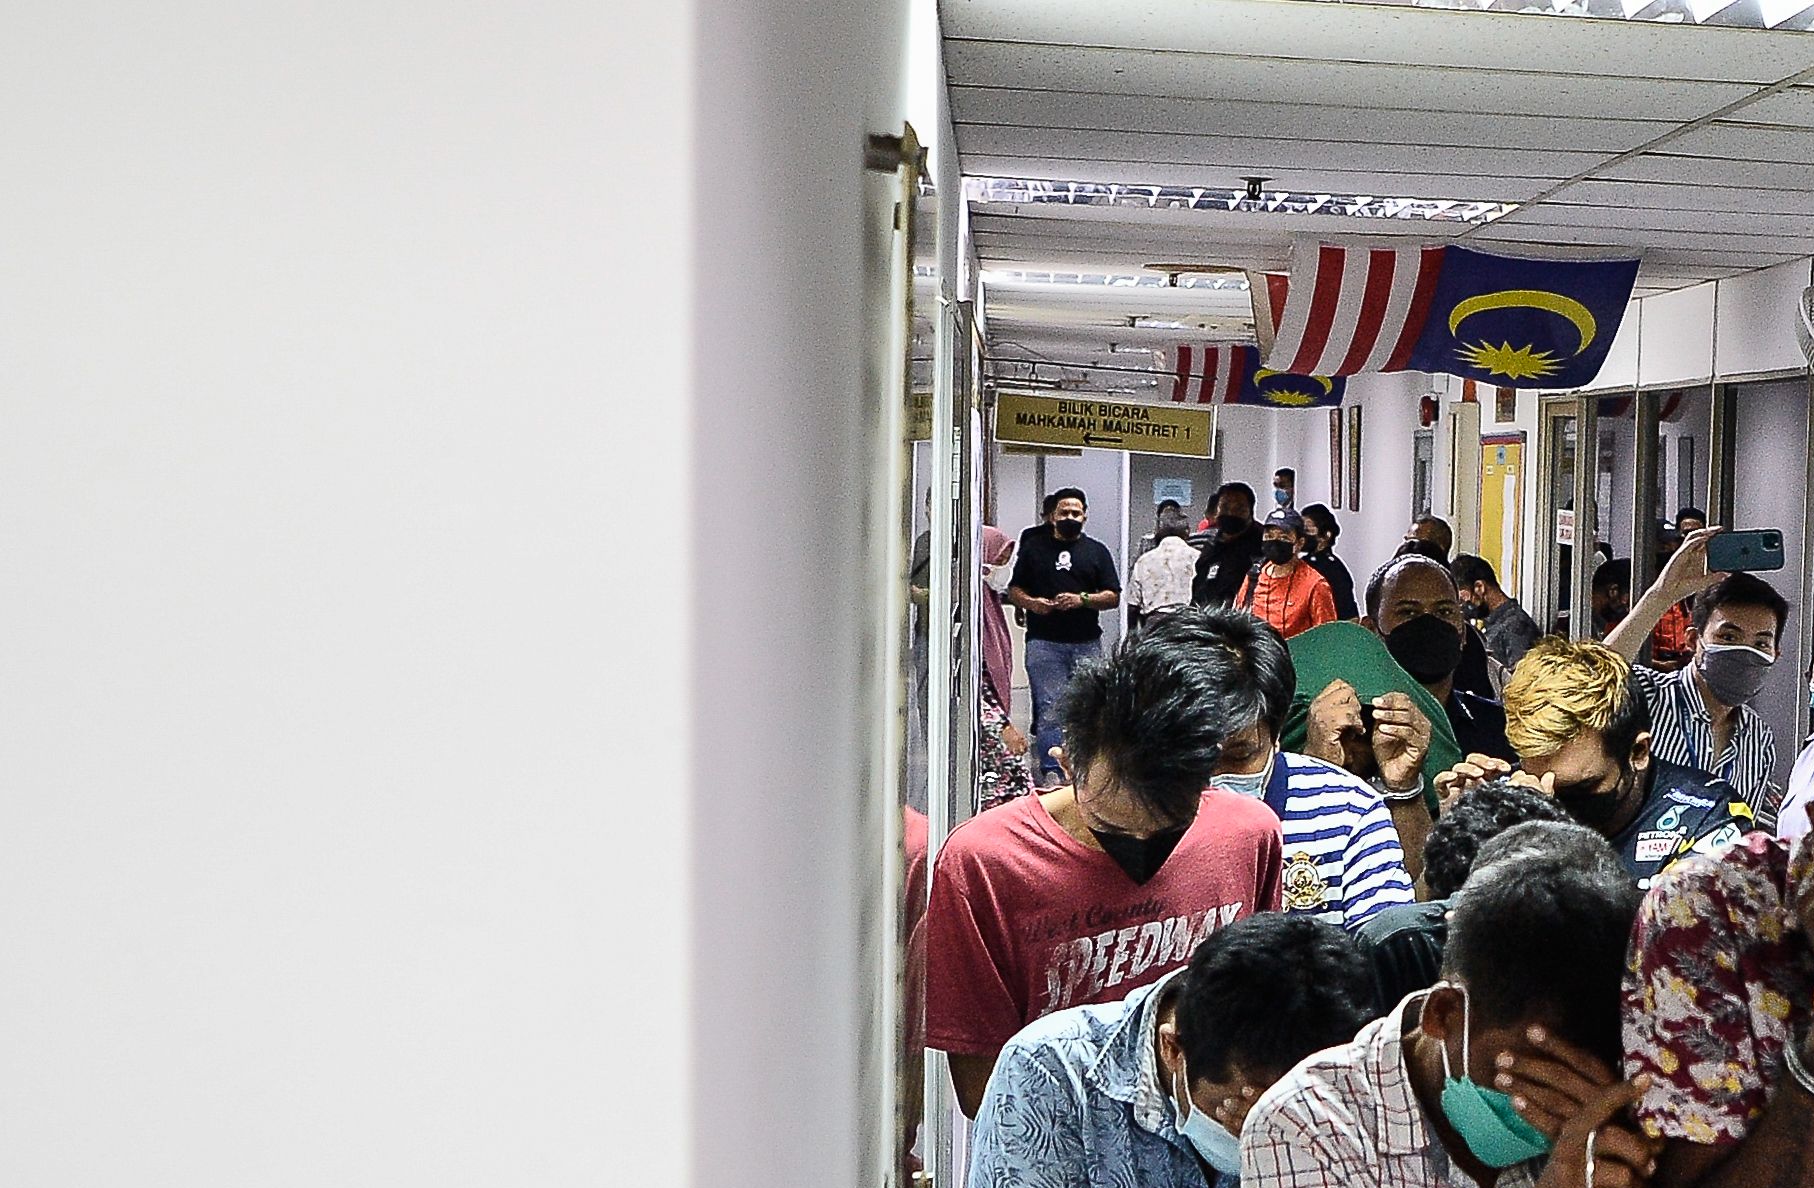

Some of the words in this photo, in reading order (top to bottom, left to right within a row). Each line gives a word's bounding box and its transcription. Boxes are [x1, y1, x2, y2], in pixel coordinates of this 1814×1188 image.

[1057, 401, 1094, 417] BILIK
[1099, 405, 1150, 421] BICARA
[1015, 412, 1097, 431] MAHKAMAH
[1102, 420, 1178, 439] MAJISTRET
[1184, 427, 1192, 440] 1
[1040, 902, 1243, 1016] SPEEDWAY
